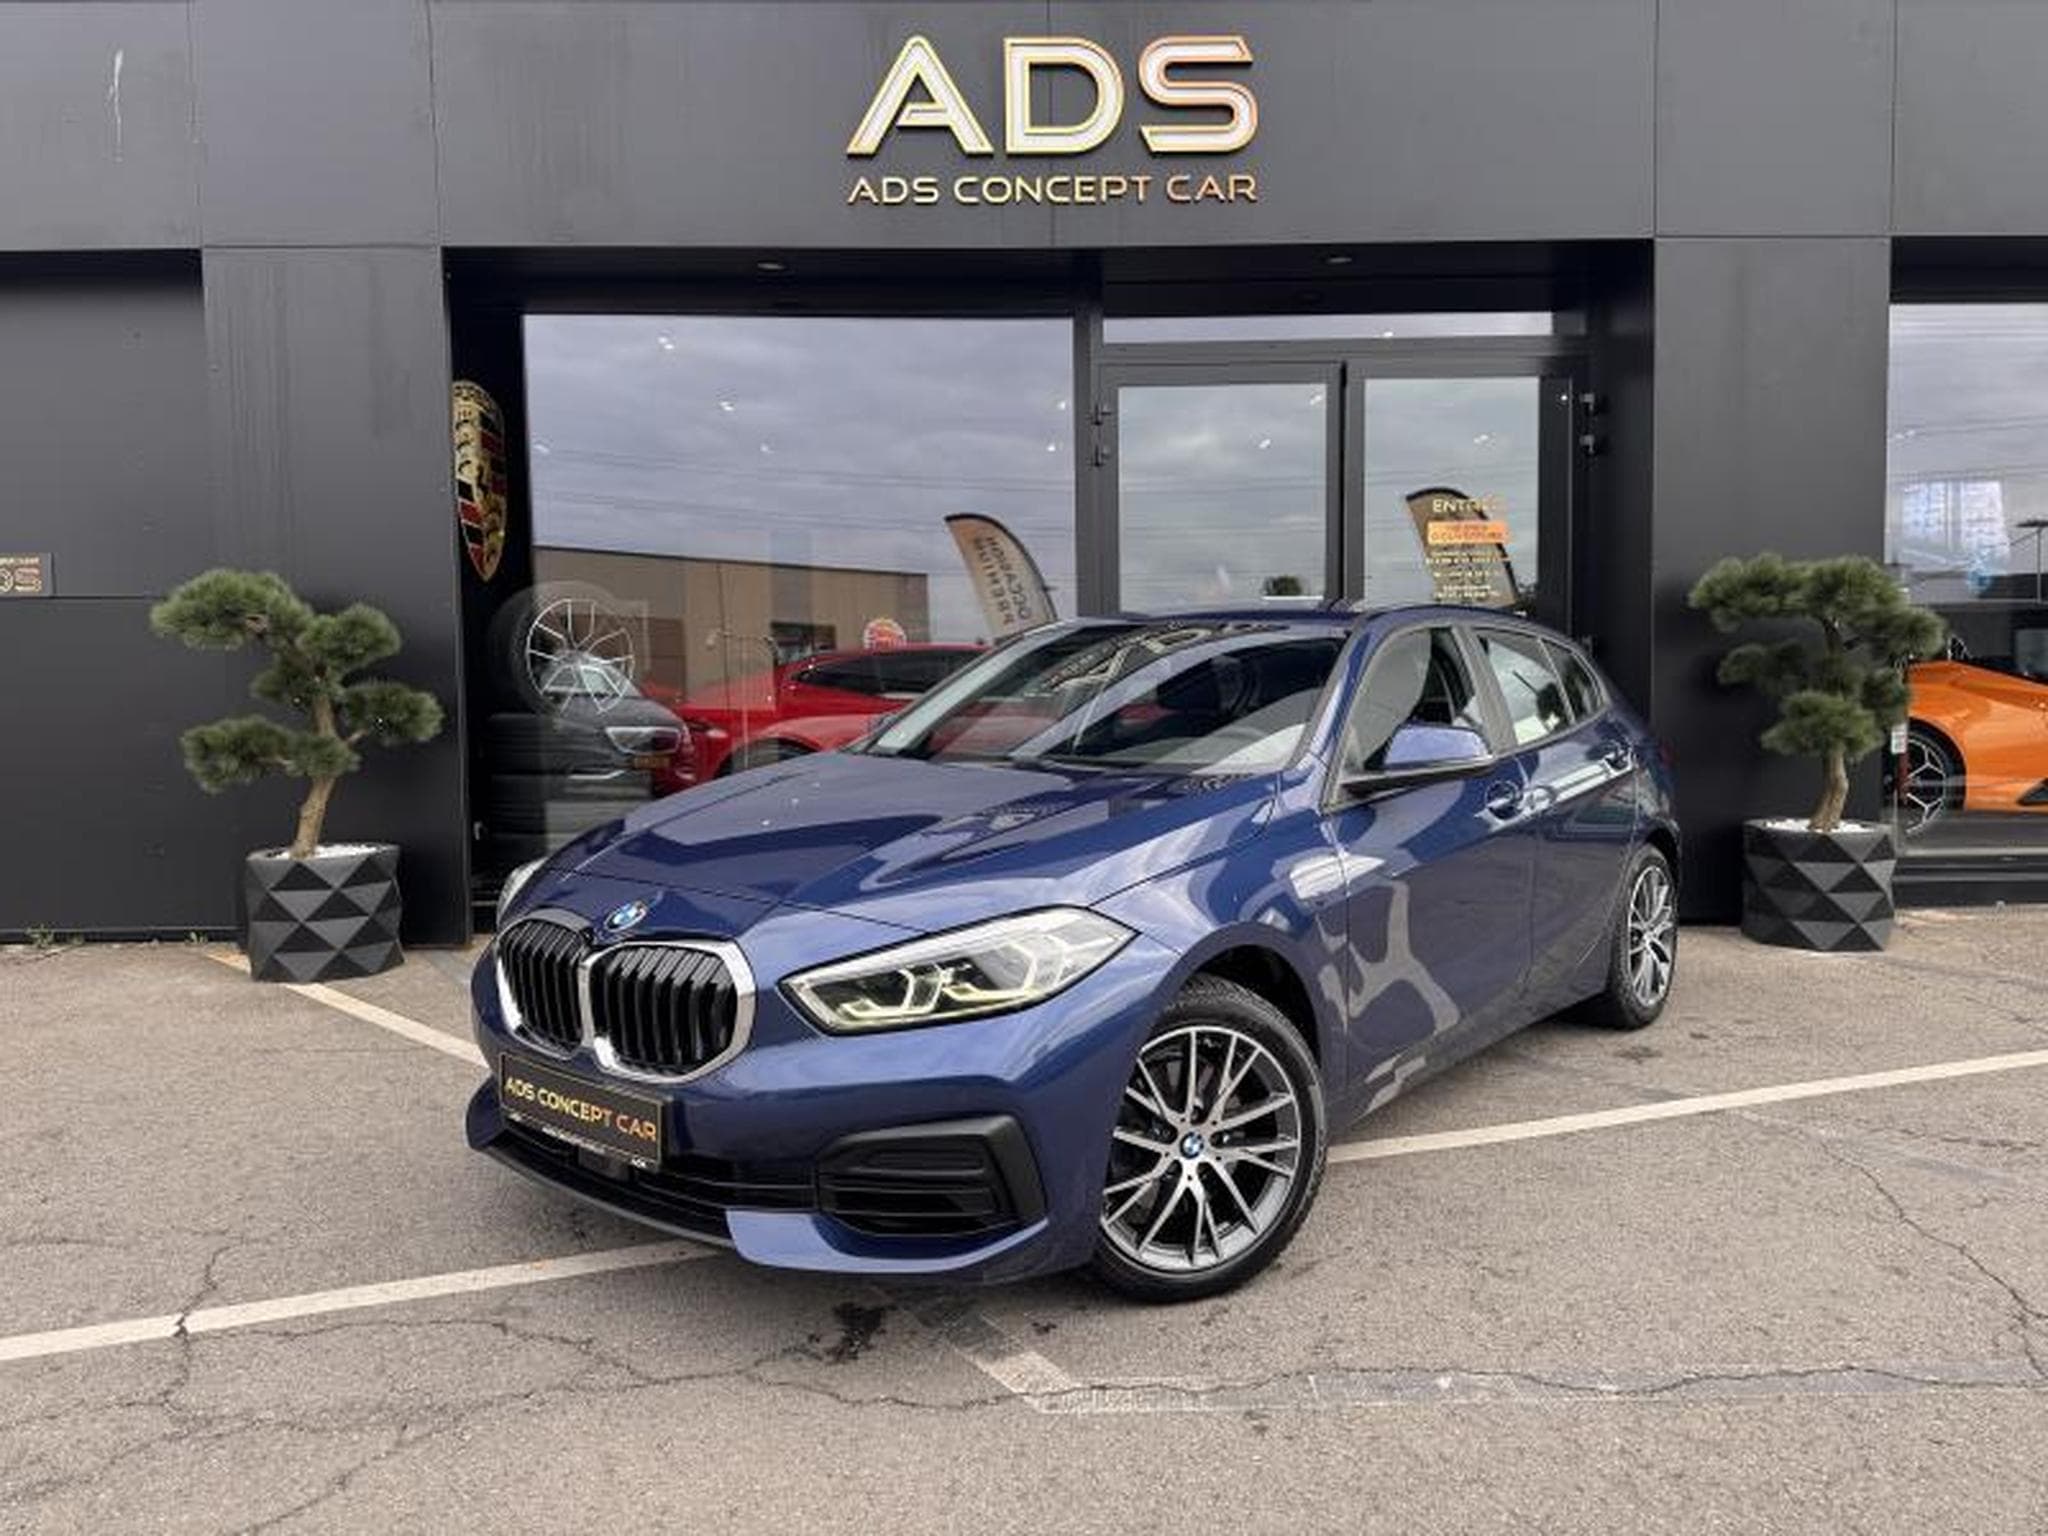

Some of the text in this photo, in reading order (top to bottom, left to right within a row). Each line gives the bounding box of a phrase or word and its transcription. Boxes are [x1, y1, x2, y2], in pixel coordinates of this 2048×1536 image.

[847, 34, 1259, 155] ADS
[848, 174, 1258, 204] ADS CONCEPT CAR
[505, 1076, 536, 1101] ADS
[537, 1088, 613, 1128] CONCEPT
[615, 1114, 657, 1143] CAR
